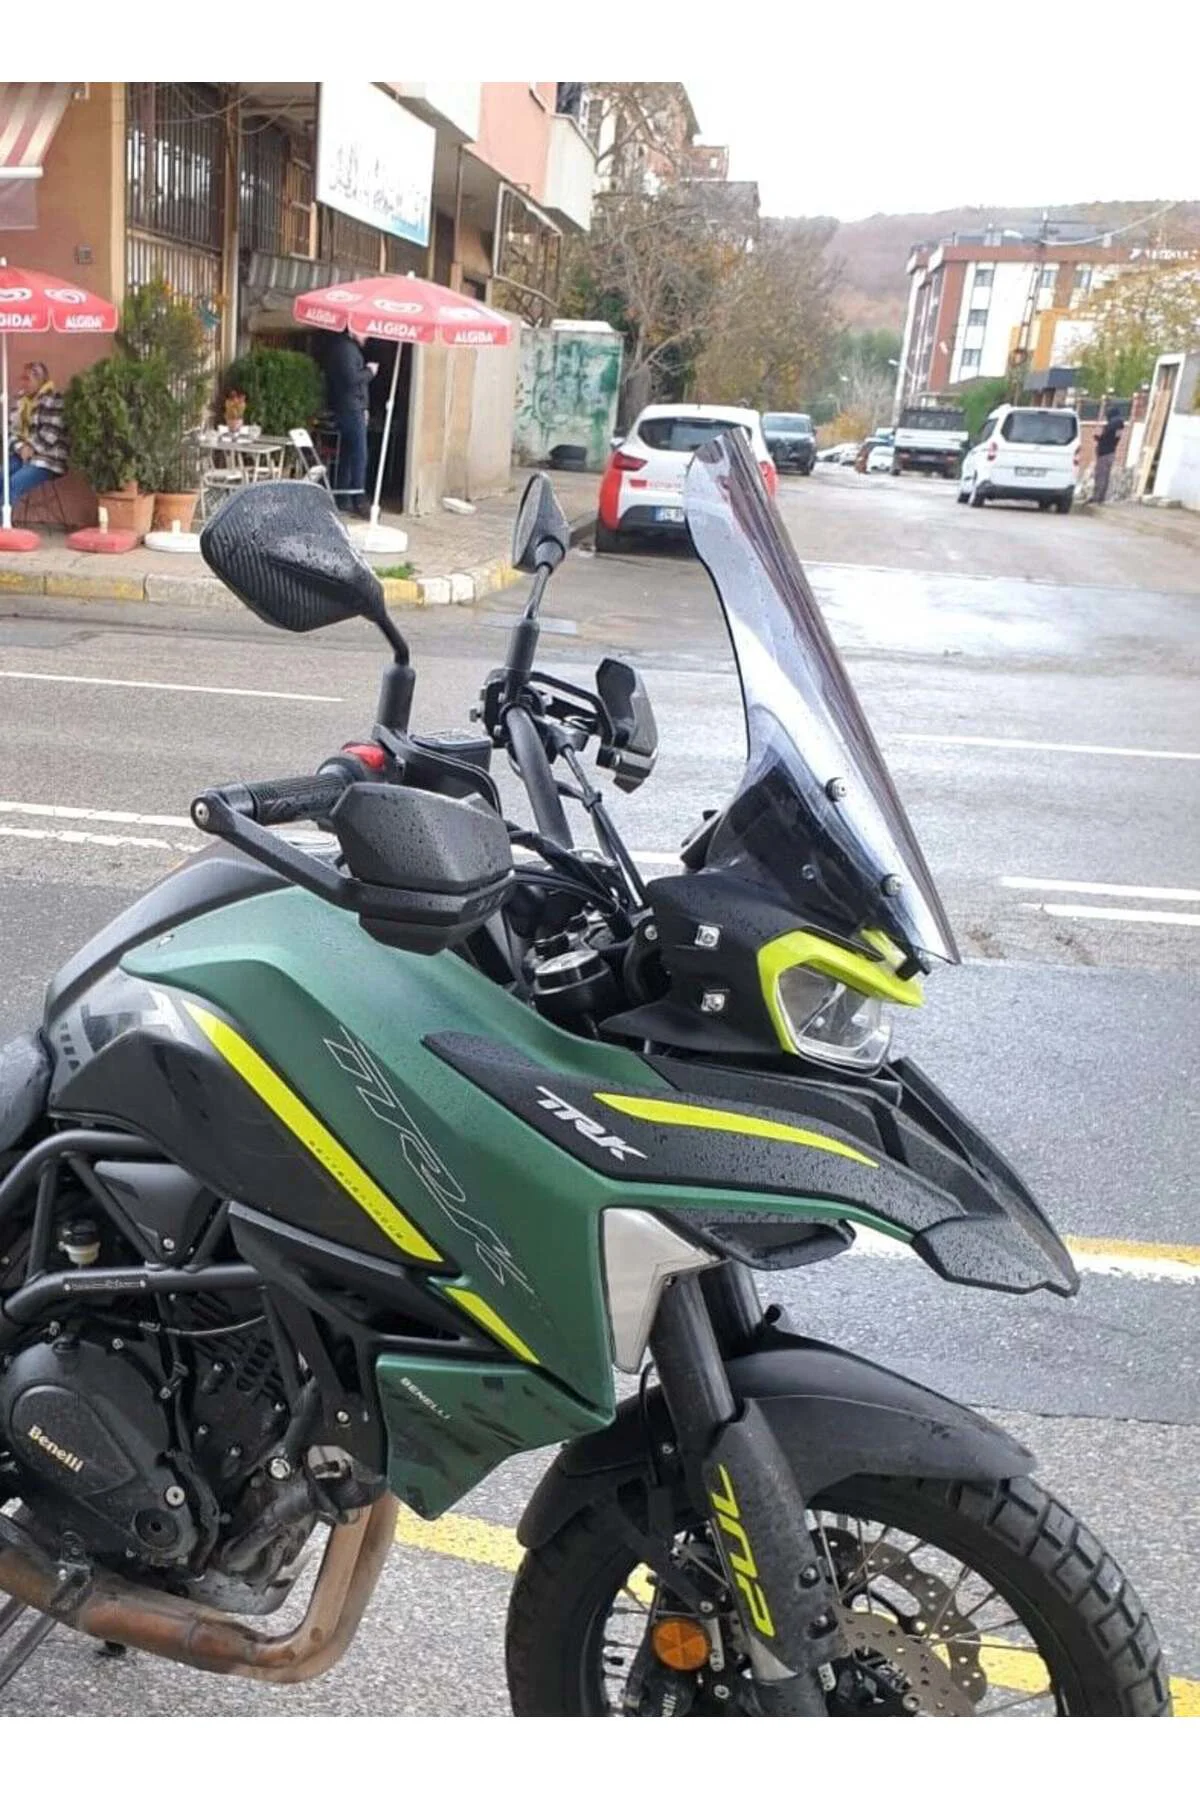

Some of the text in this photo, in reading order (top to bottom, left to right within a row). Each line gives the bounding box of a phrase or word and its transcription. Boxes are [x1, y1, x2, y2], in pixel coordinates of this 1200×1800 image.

[64, 314, 103, 329] ALGIDA
[305, 308, 337, 325] ALGIDA
[366, 319, 418, 338] ALGIDA
[454, 330, 493, 343] ALGIDA
[536, 1085, 648, 1160] TRK
[322, 1025, 534, 1294] TRK
[400, 1376, 453, 1420] BENELLI
[28, 1424, 84, 1473] Benelli
